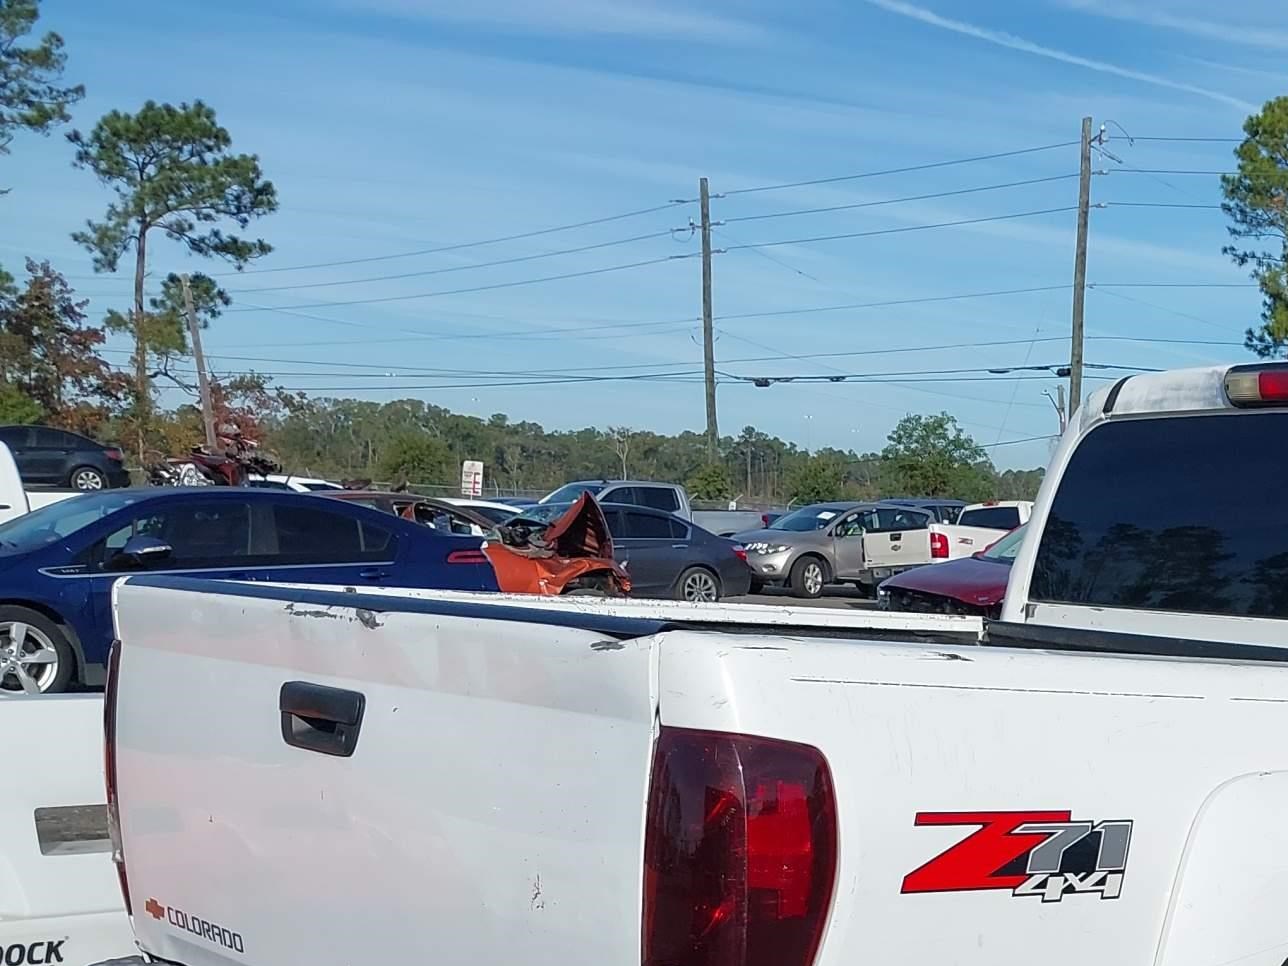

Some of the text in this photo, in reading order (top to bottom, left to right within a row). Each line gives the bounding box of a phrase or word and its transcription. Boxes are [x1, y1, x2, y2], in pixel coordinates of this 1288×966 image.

[901, 810, 1134, 894] Z71
[0, 940, 65, 966] OCK
[167, 906, 244, 954] COLORADO
